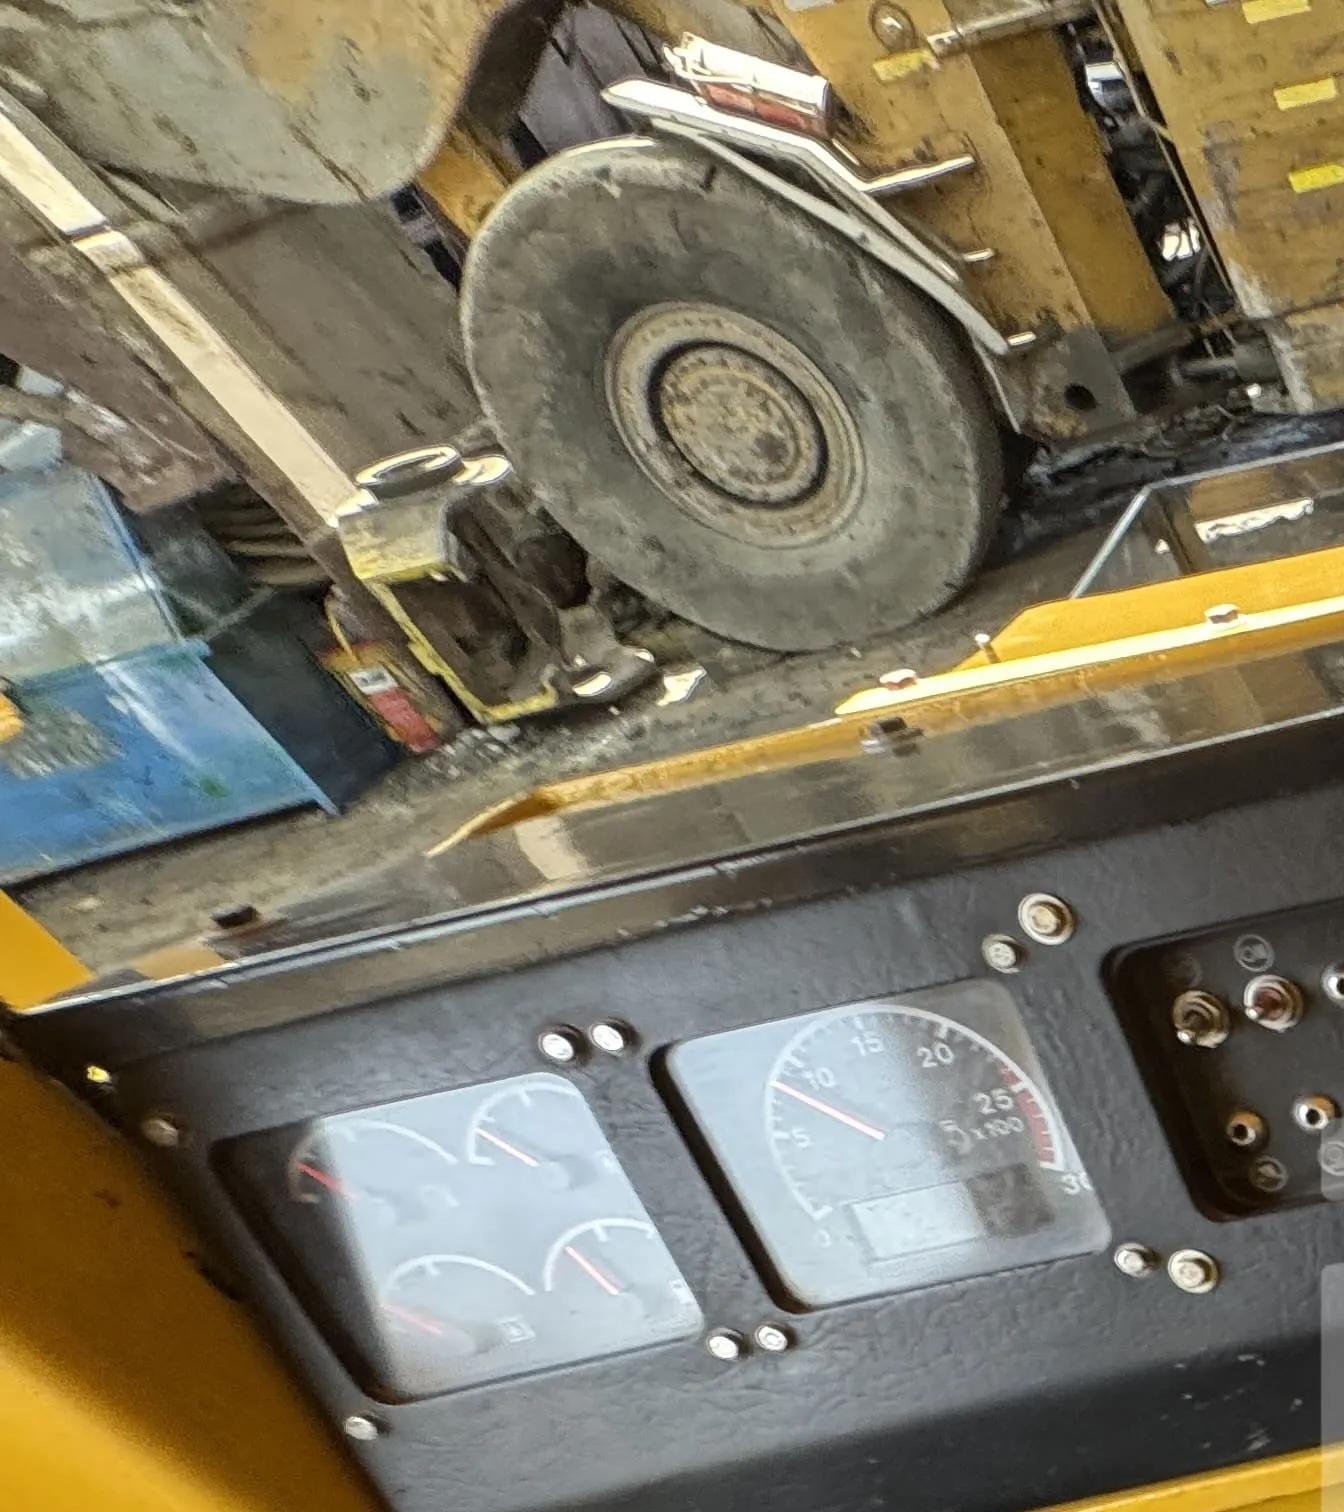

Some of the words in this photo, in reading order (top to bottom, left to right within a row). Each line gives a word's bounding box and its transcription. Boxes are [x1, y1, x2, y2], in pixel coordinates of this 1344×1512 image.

[851, 1033, 884, 1057] 15
[916, 1042, 954, 1069] 20
[801, 1066, 836, 1091] 10
[972, 1088, 1015, 1115] 25
[792, 1127, 812, 1149] 5
